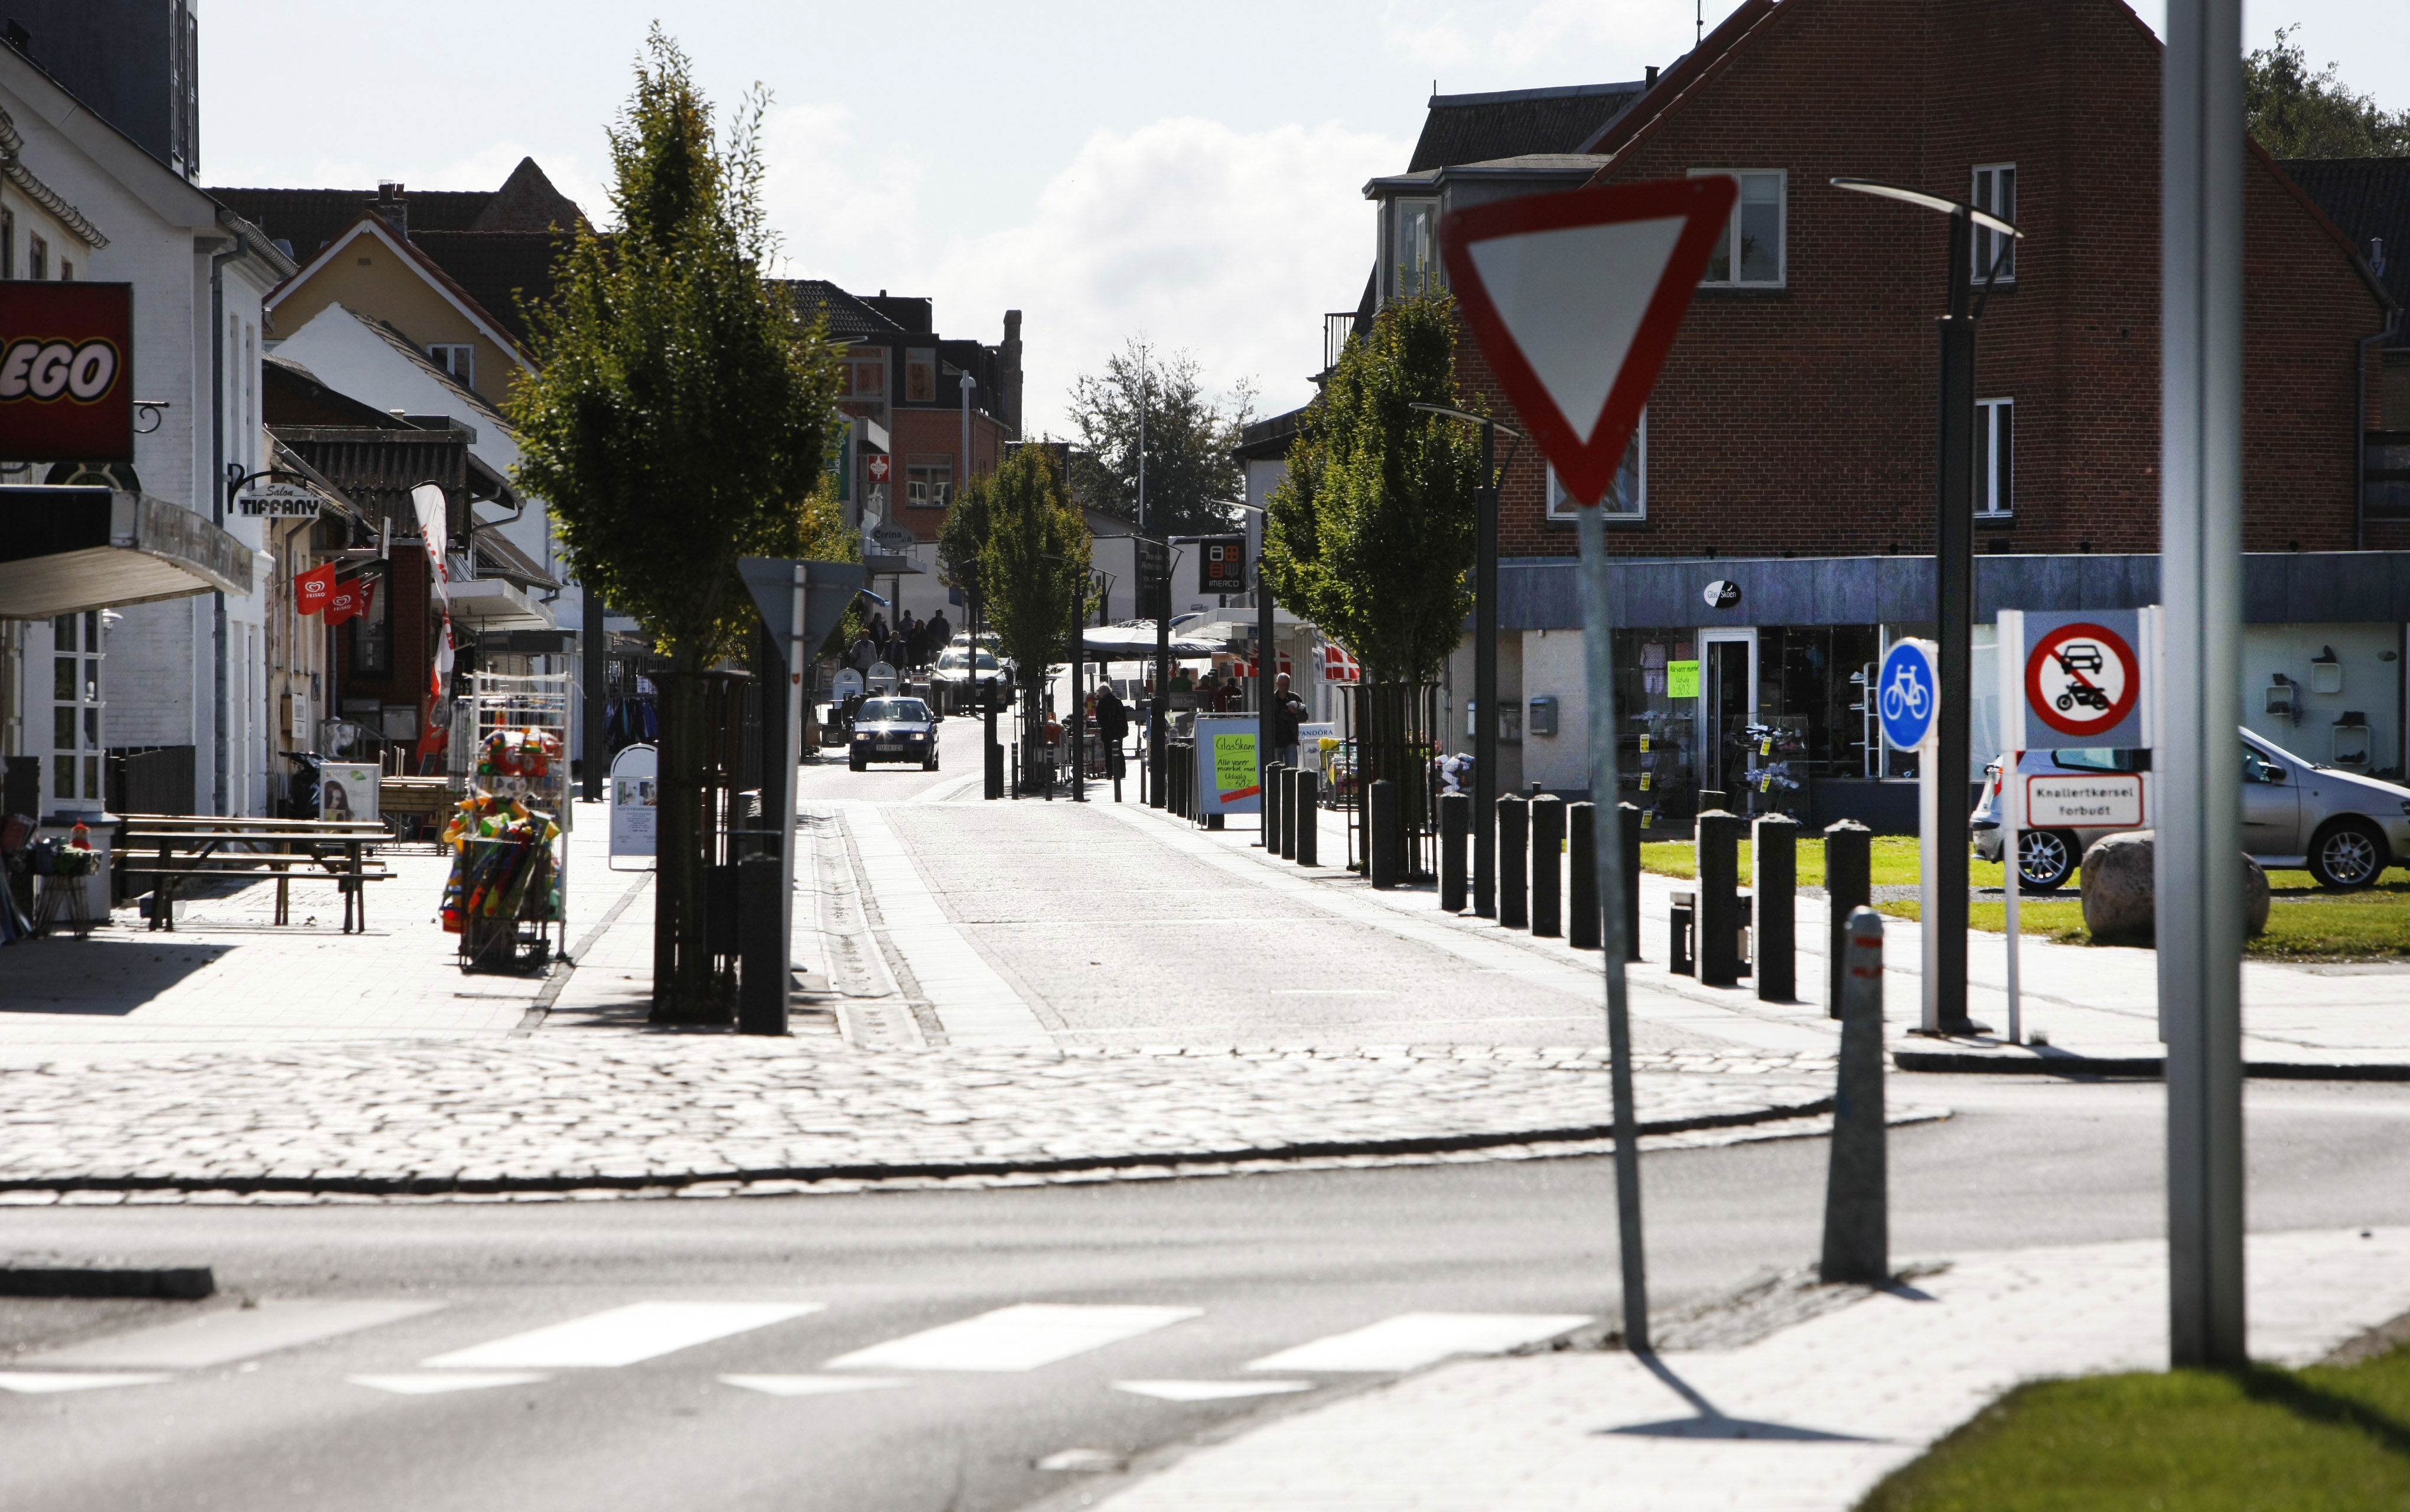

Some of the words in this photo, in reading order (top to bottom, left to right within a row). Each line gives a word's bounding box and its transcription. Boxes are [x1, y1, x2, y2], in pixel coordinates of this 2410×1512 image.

[0, 343, 115, 398] EGO
[266, 485, 294, 496] Salon
[240, 499, 318, 514] TIFFANY
[1721, 590, 1737, 598] Skoen
[2059, 806, 2112, 816] forbudt
